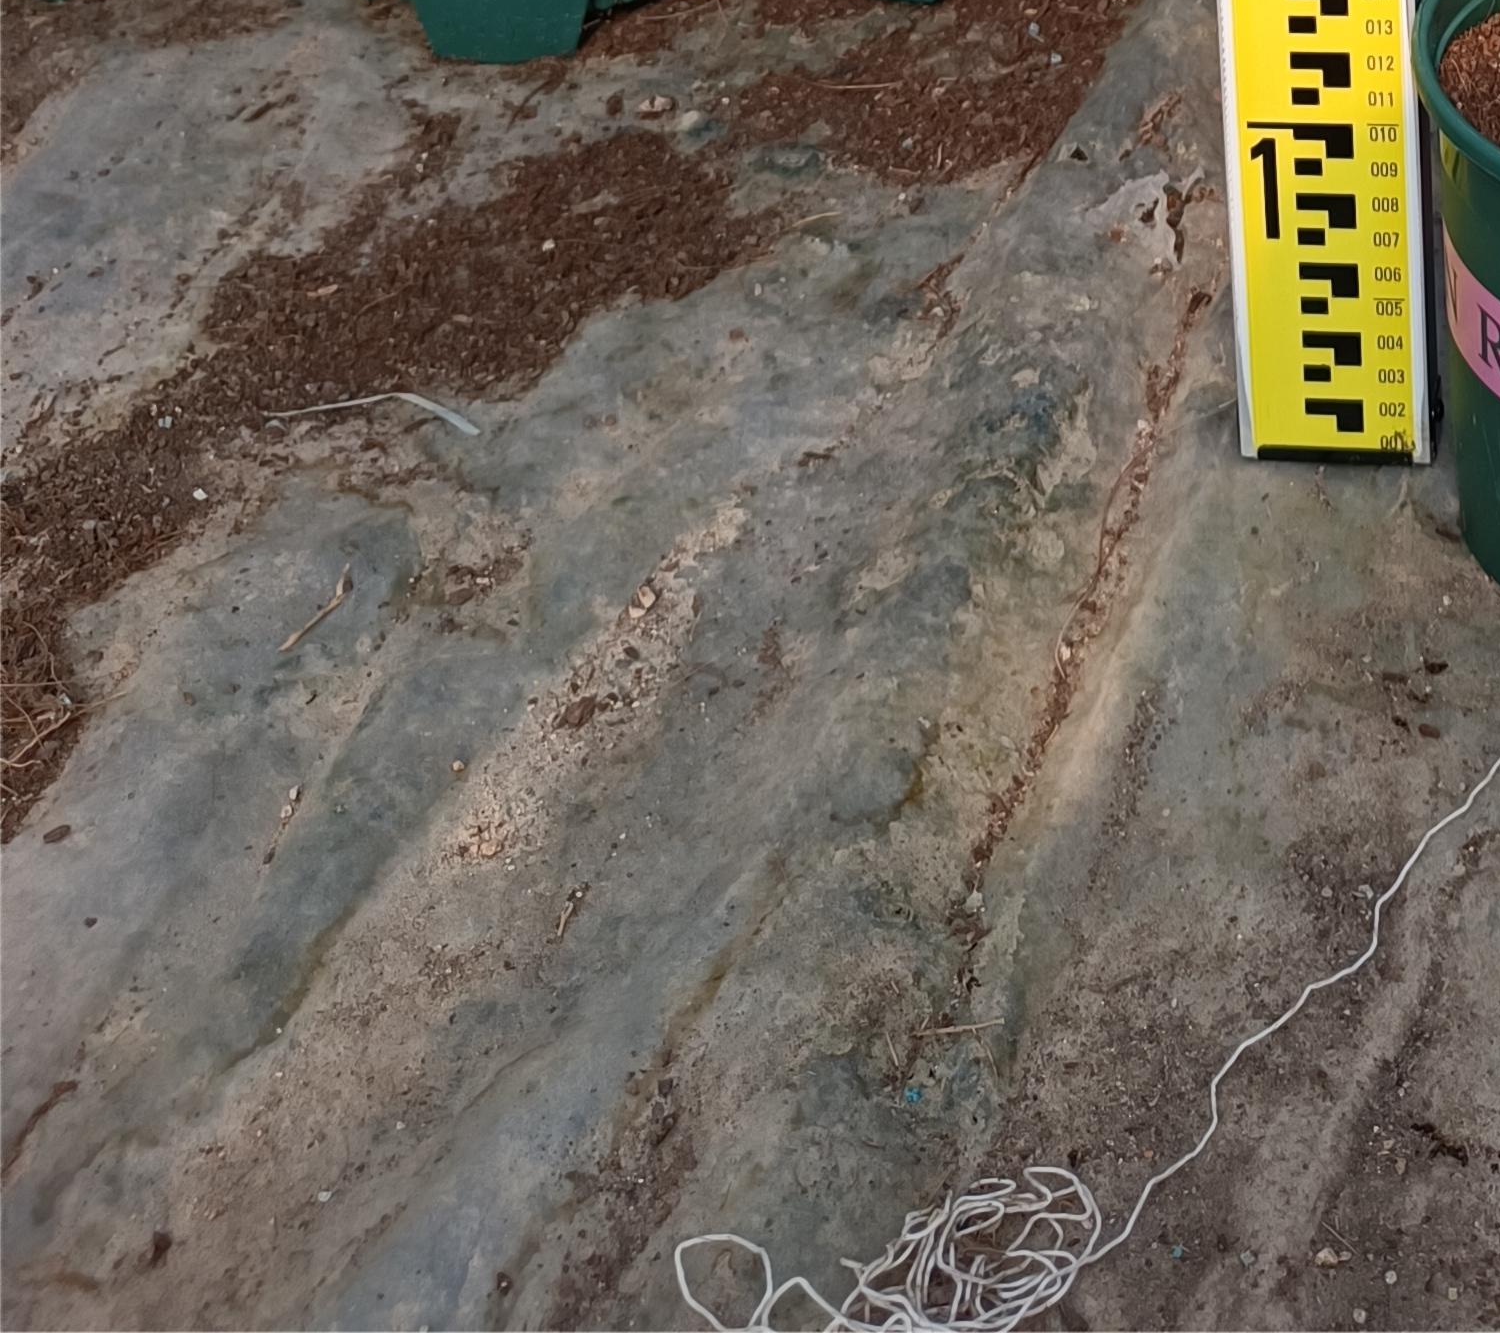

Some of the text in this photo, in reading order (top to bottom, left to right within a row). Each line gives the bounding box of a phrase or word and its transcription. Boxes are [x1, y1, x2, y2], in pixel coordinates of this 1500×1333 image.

[1365, 18, 1393, 36] 013
[1366, 54, 1395, 72] 012
[1367, 90, 1394, 108] 011
[1369, 126, 1398, 143] 010
[1370, 161, 1399, 178] 009
[1251, 138, 1280, 240] 1
[1371, 196, 1400, 214] 008
[1372, 231, 1400, 249] 007
[1374, 266, 1402, 283] 006
[1375, 300, 1403, 317] 005
[1376, 334, 1404, 351] 004
[1377, 368, 1405, 385] 003
[1378, 401, 1406, 418] 002
